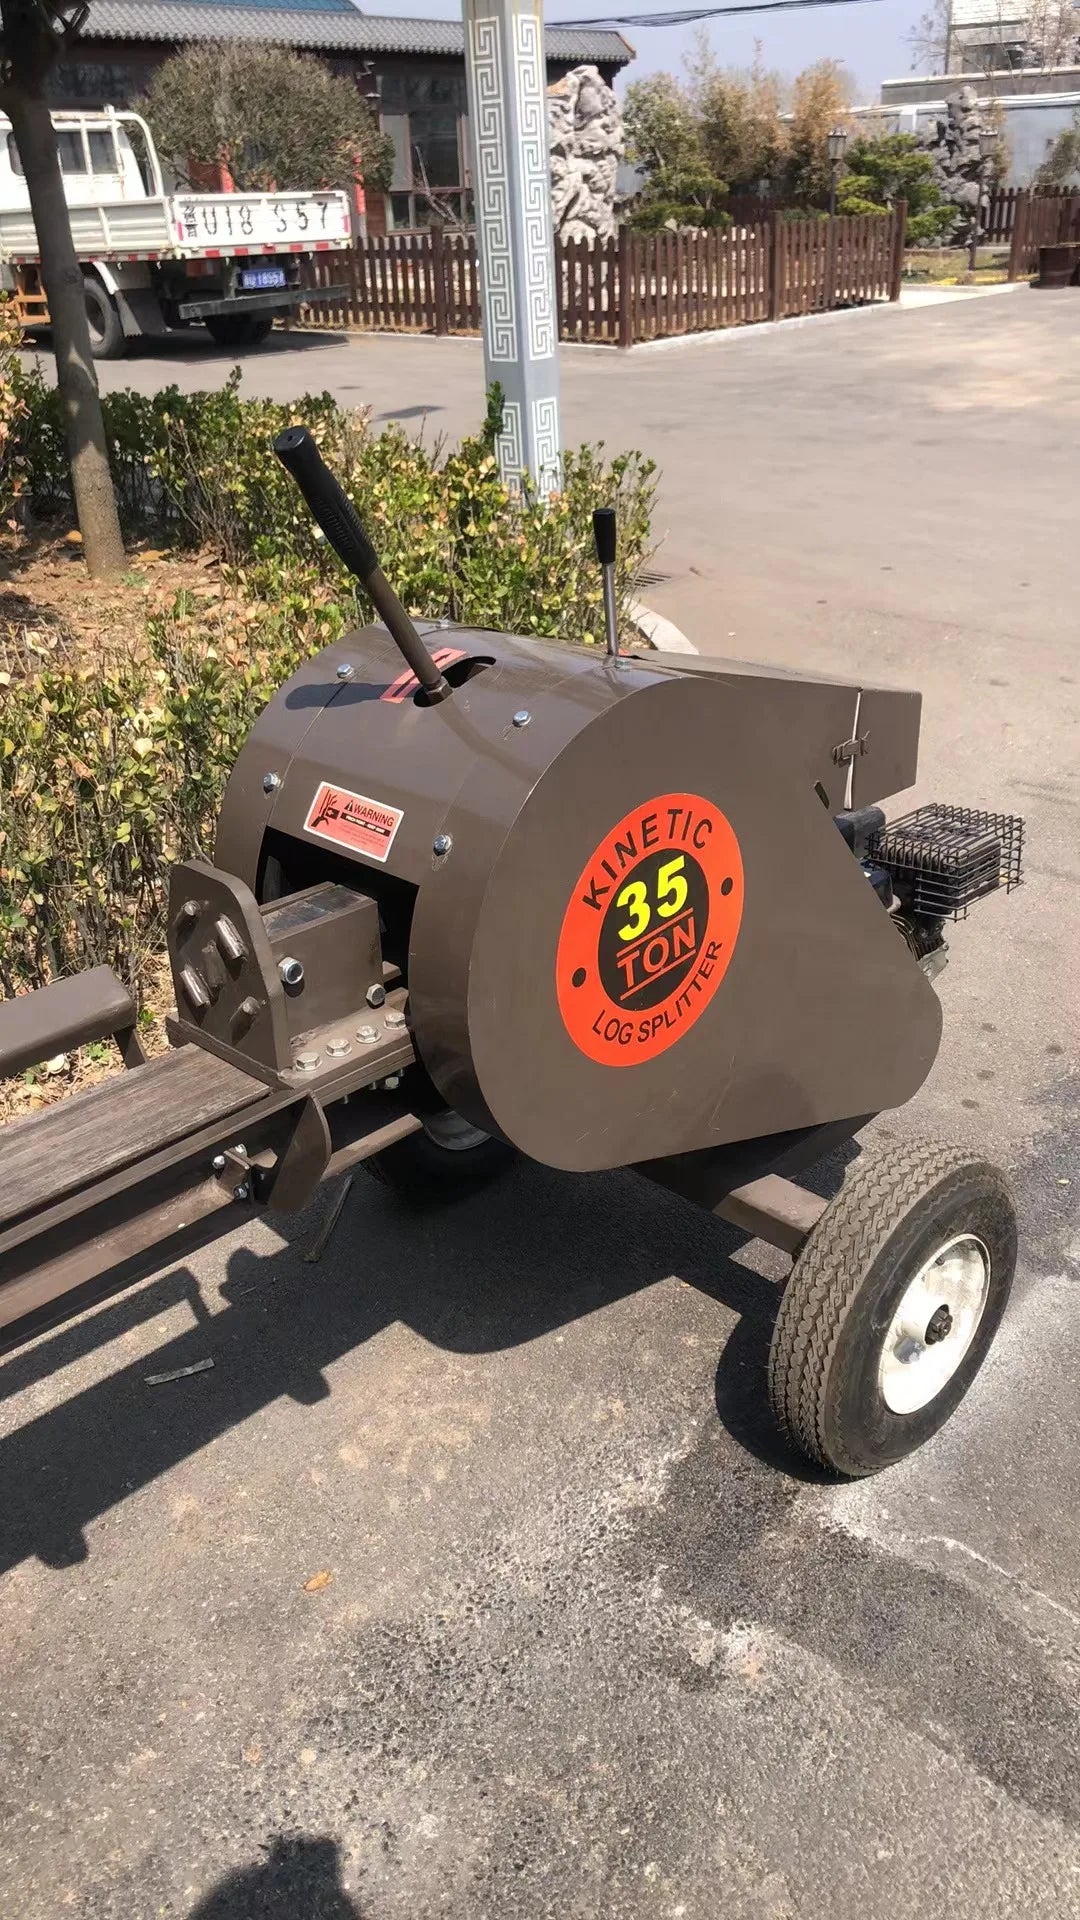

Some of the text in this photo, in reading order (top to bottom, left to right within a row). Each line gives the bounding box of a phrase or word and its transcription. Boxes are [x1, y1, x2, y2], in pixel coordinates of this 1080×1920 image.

[353, 803, 395, 828] WARNING
[582, 808, 713, 911] KINETIC
[616, 855, 689, 942] 35
[592, 940, 723, 1045] LOG SPLITTER
[617, 916, 697, 989] TON
